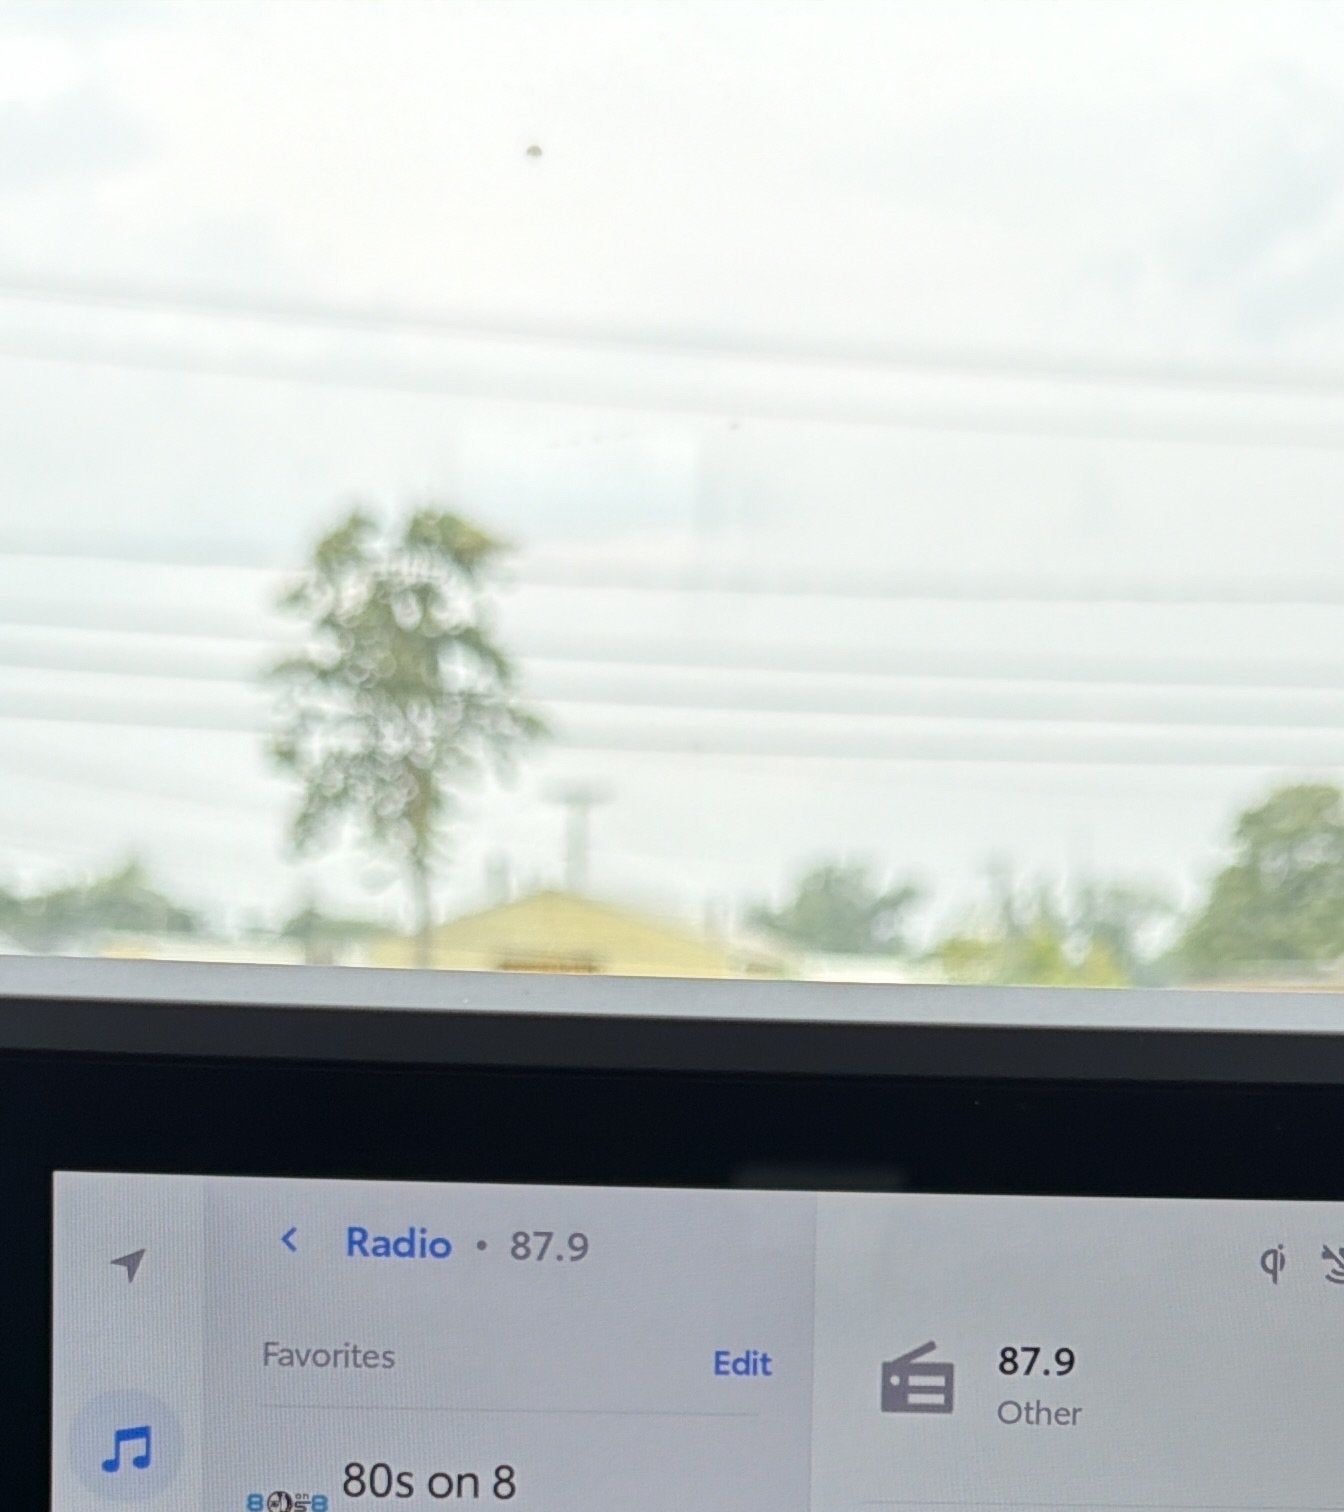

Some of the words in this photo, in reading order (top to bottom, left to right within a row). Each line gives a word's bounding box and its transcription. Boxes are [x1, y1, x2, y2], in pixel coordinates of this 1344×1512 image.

[346, 1226, 453, 1260] Radio
[509, 1230, 590, 1263] 87.9
[262, 1341, 396, 1370] Favorites
[713, 1349, 773, 1377] Edit
[997, 1345, 1076, 1379] 87.9
[997, 1399, 1083, 1429] Other
[342, 1462, 415, 1500] 80s
[427, 1470, 480, 1500] on
[493, 1464, 517, 1501] 8
